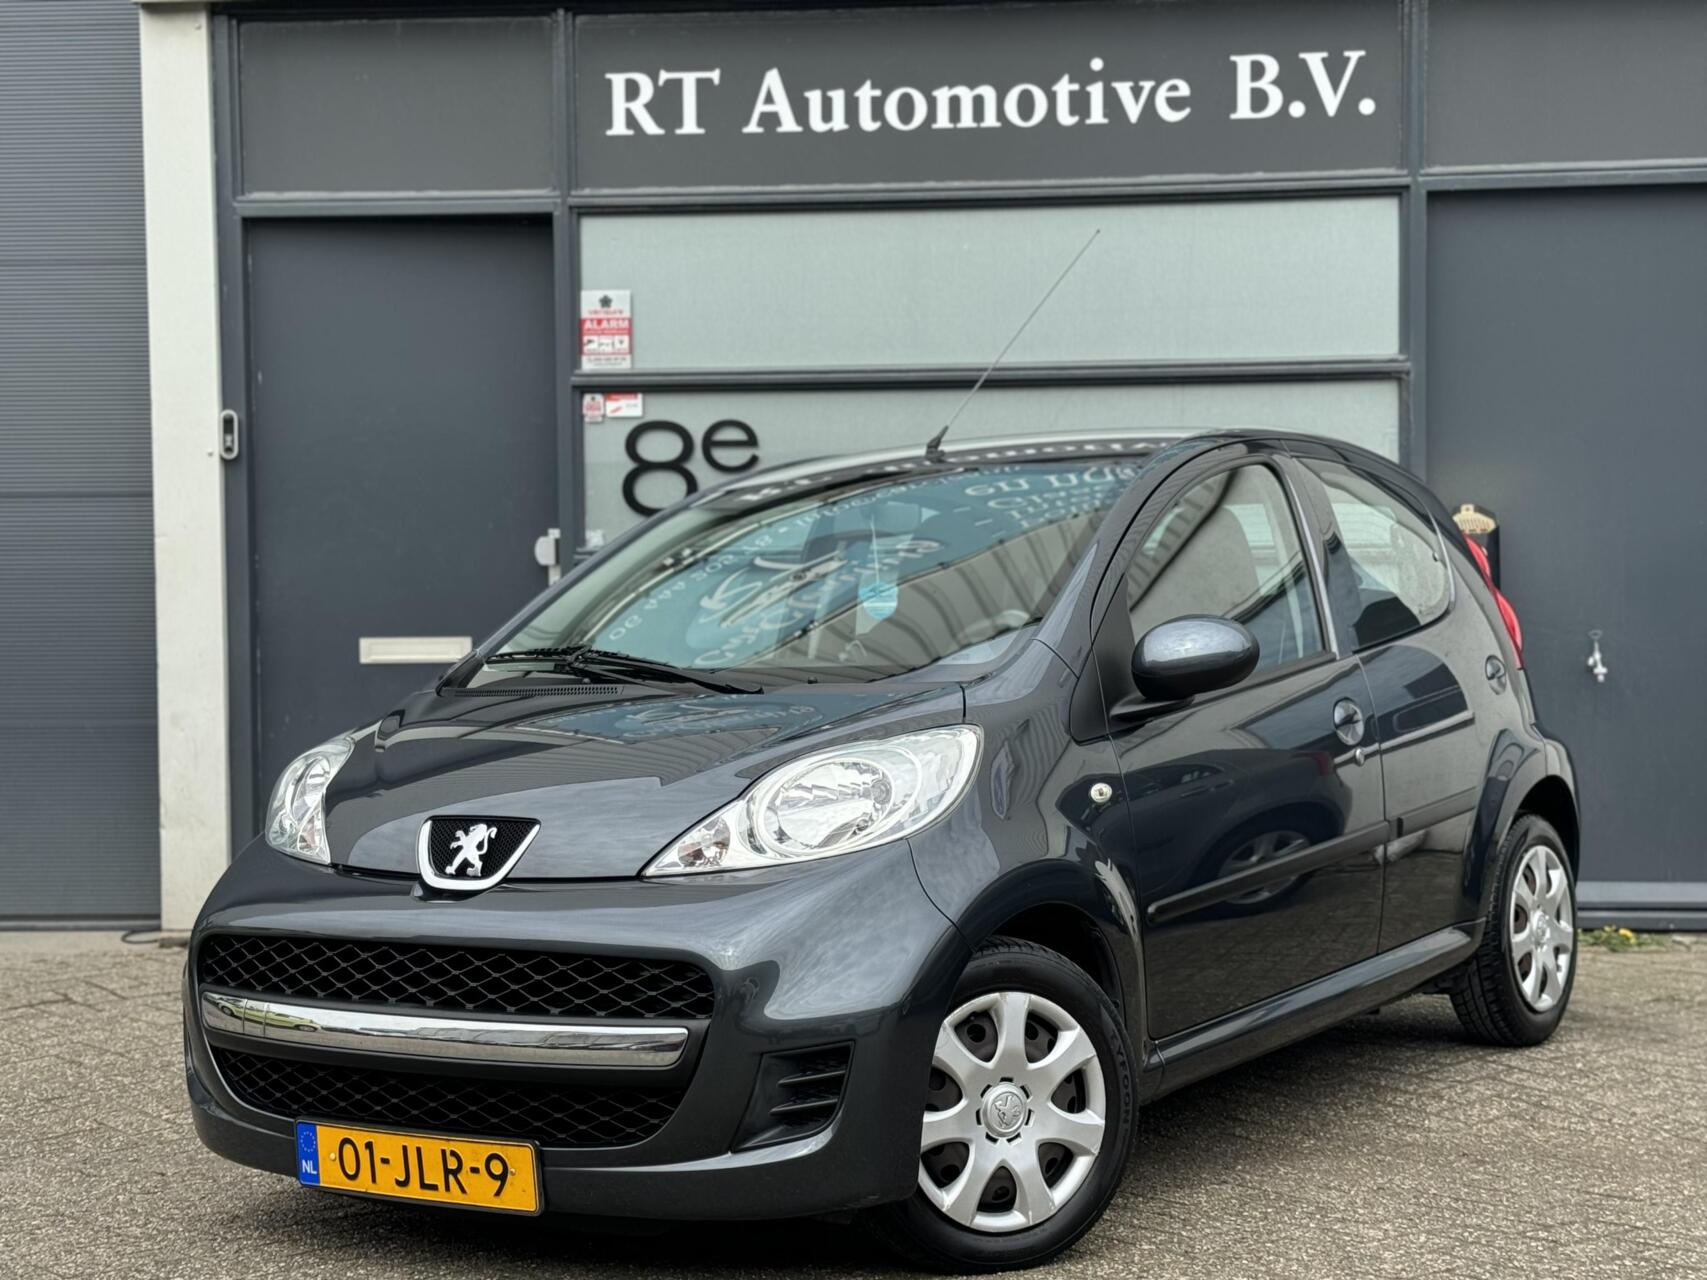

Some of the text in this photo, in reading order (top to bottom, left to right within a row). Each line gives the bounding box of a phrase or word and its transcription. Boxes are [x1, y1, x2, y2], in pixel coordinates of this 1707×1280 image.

[605, 50, 1376, 136] RT Automotive B.V.
[584, 319, 629, 329] ALARM
[302, 1160, 317, 1175] NL
[338, 1137, 509, 1197] 01-JLR-9
